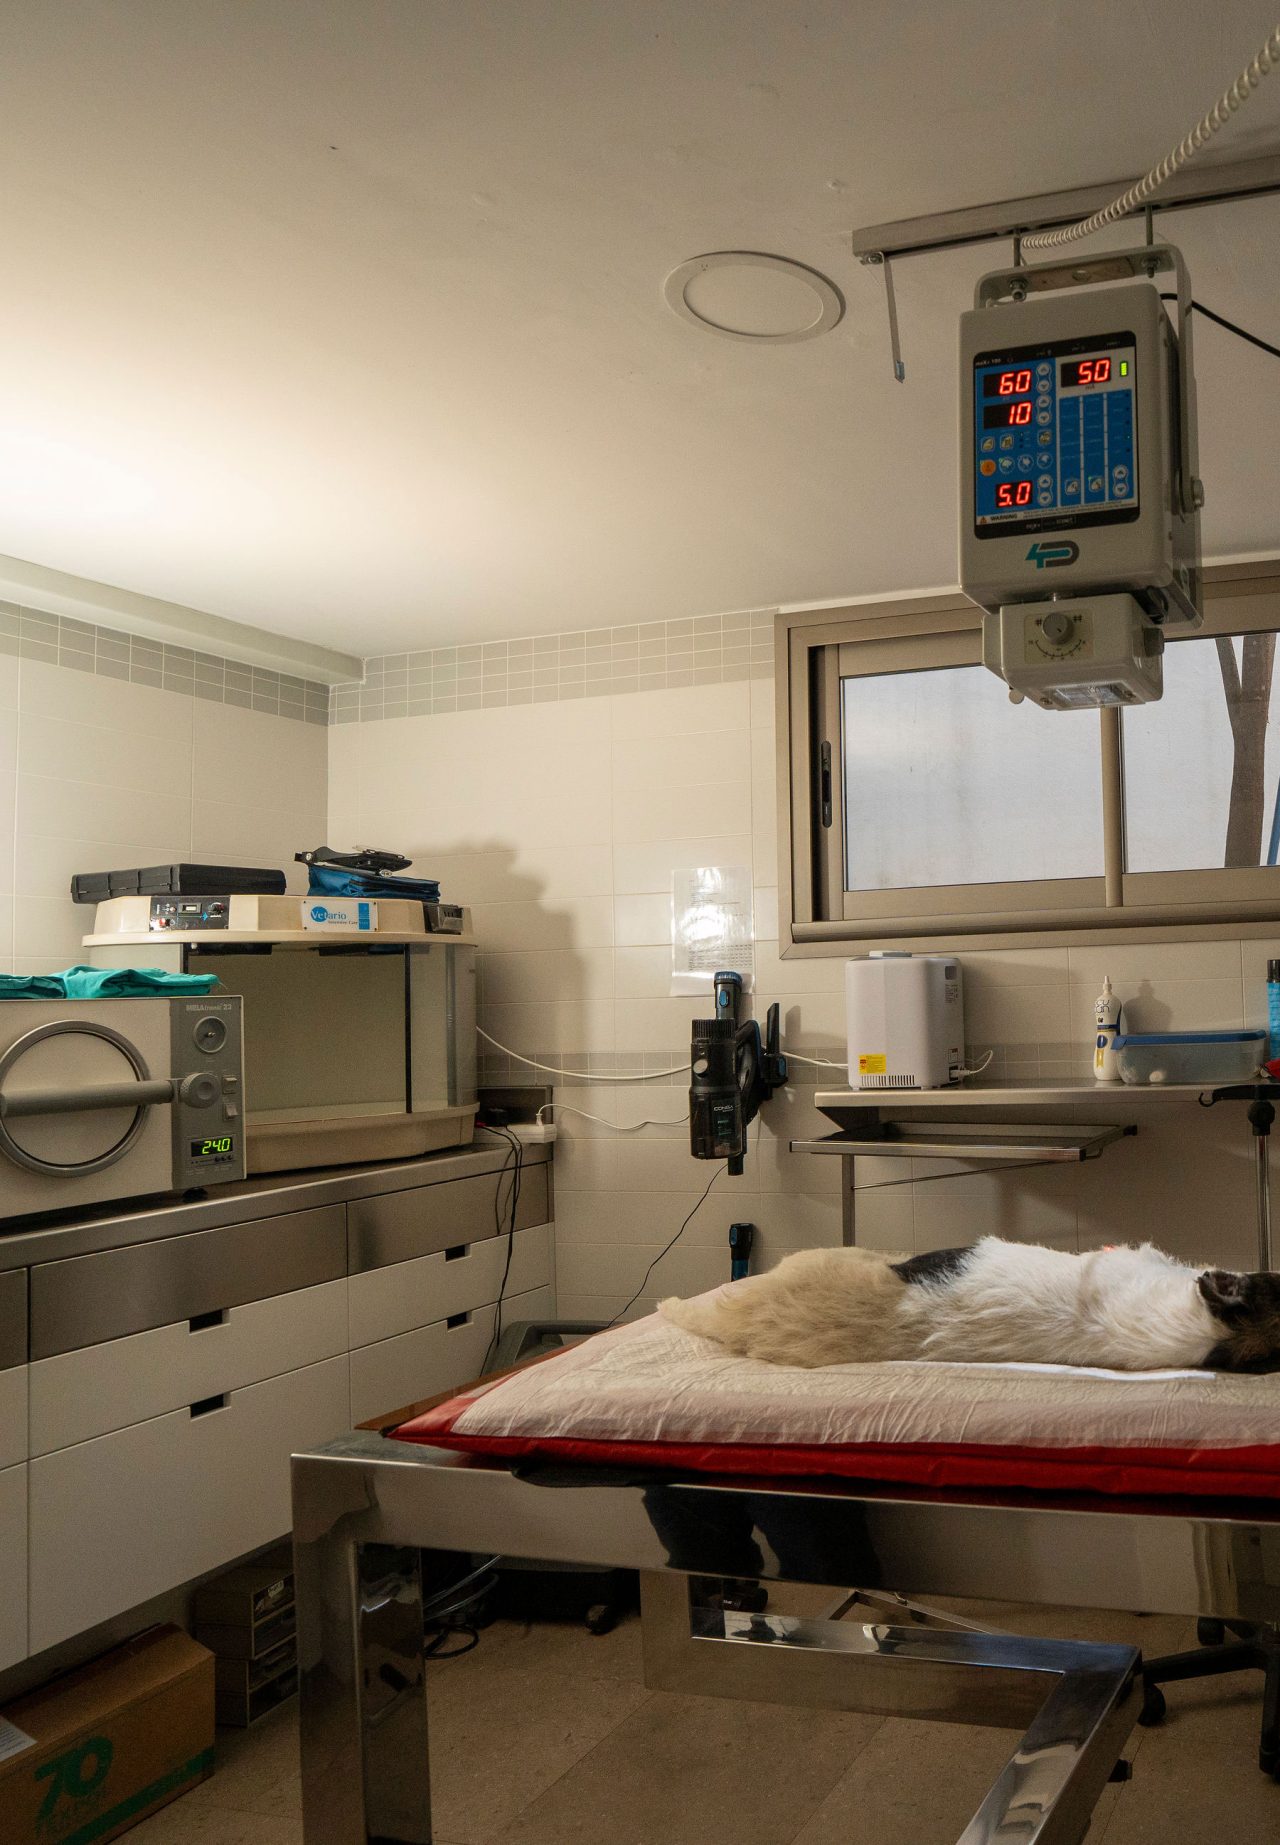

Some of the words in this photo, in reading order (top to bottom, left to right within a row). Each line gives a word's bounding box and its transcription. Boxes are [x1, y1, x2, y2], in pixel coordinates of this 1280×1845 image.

[998, 370, 1032, 395] 60
[1078, 359, 1111, 385] 50
[1008, 401, 1032, 424] 10
[990, 513, 1018, 521] WARNING
[311, 909, 347, 920] Vetario
